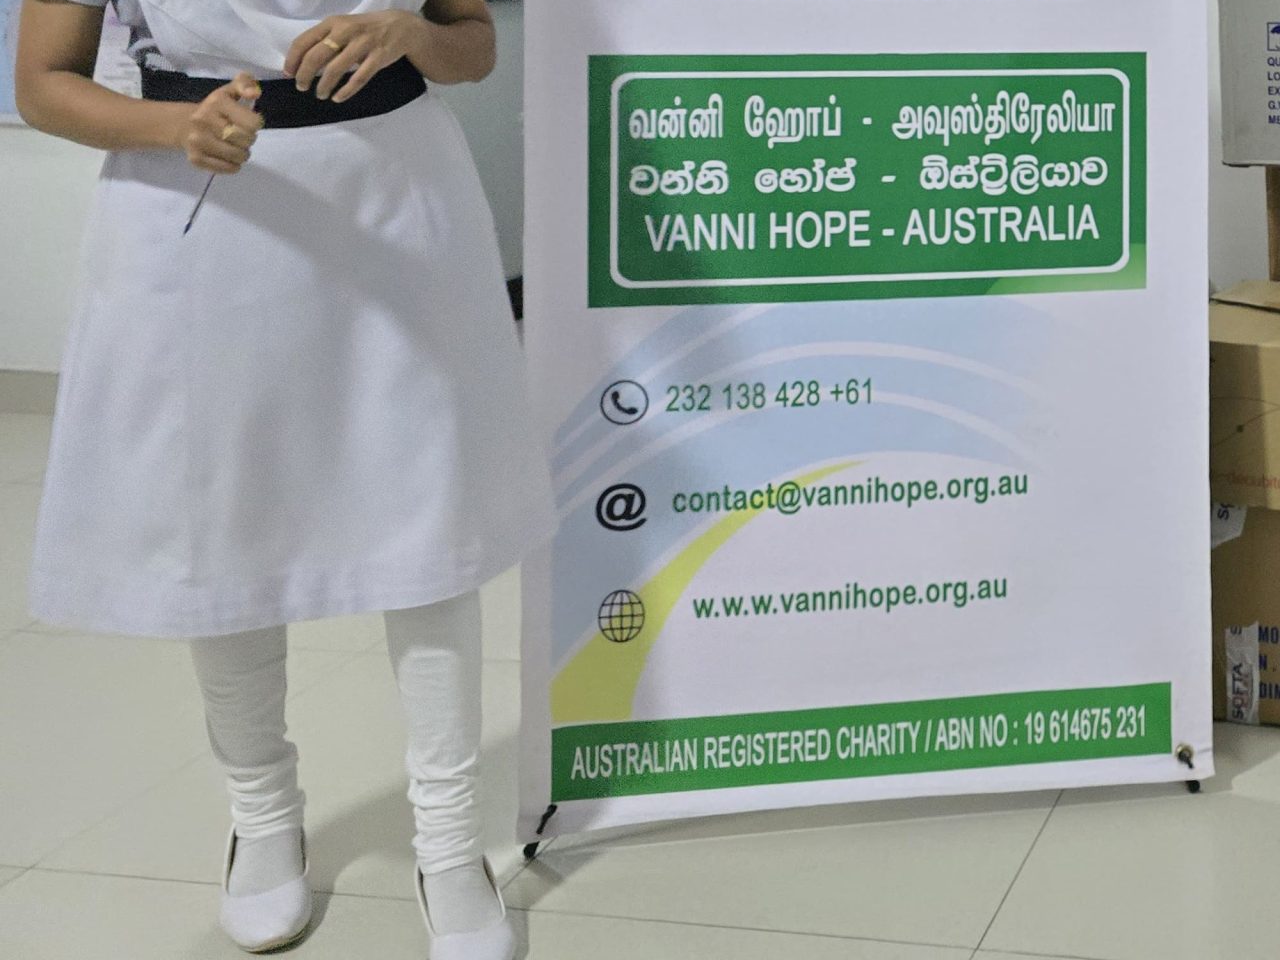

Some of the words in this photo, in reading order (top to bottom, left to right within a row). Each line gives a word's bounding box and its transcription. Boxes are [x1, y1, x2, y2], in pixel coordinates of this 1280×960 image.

[629, 93, 724, 140] வன்னி
[744, 94, 842, 149] ஹோப்
[891, 90, 1116, 146] அவுஸ்திரேலியா
[645, 212, 756, 252] VANNI
[769, 210, 872, 249] HOPE
[902, 204, 1100, 247] AUSTRALIA
[666, 385, 711, 412] 232
[722, 383, 766, 410] 138
[775, 380, 820, 407] 428
[830, 378, 873, 405] +61
[672, 473, 1029, 515] contact@vannihope.org.au
[693, 577, 1008, 619] w.w.w.vannihope.org.au
[570, 742, 699, 781] AUSTRALIAN
[703, 730, 832, 770] REGISTERED
[835, 722, 921, 761] CHARITY
[923, 721, 933, 753] /
[934, 717, 976, 752] ABN
[979, 715, 1009, 749] NO
[1024, 711, 1046, 745] 19
[1049, 708, 1113, 743] 614675
[1116, 705, 1147, 738] 231
